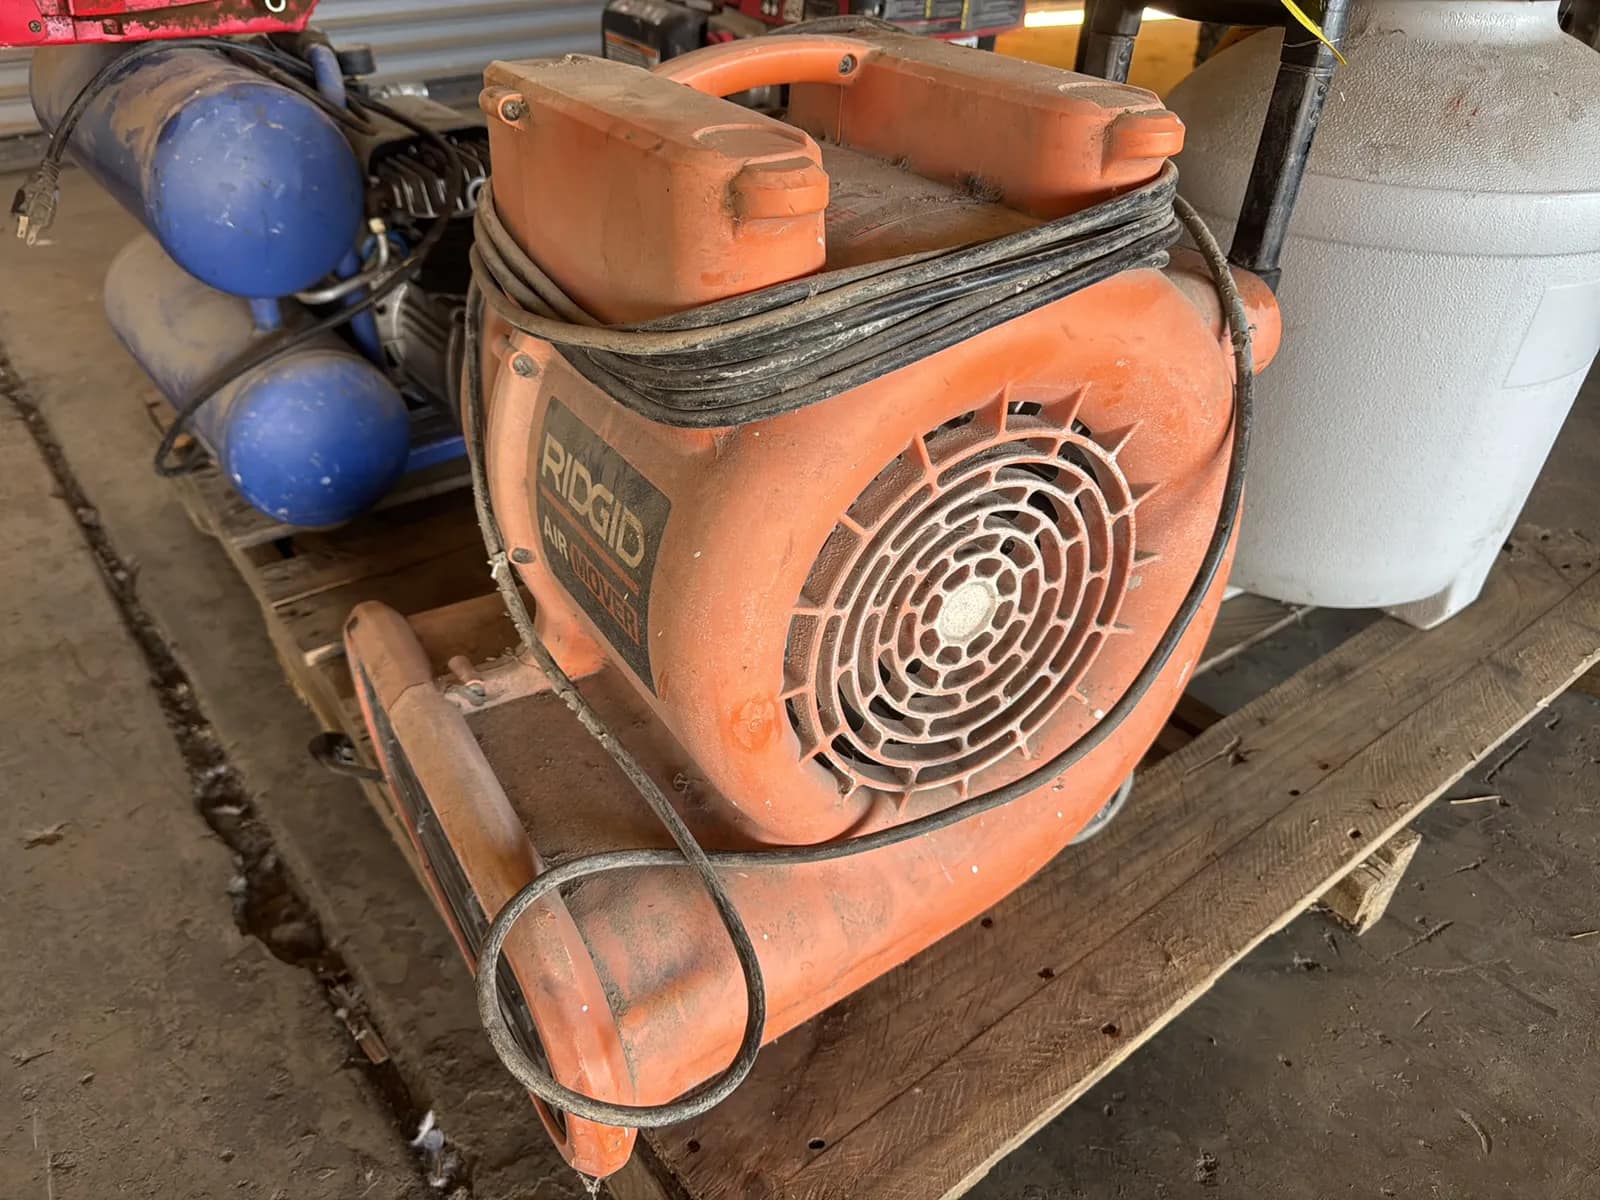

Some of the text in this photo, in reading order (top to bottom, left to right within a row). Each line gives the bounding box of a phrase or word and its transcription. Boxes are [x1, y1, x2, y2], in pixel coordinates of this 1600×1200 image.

[541, 432, 645, 569] RIDGID
[543, 515, 640, 646] AIR MOVER
